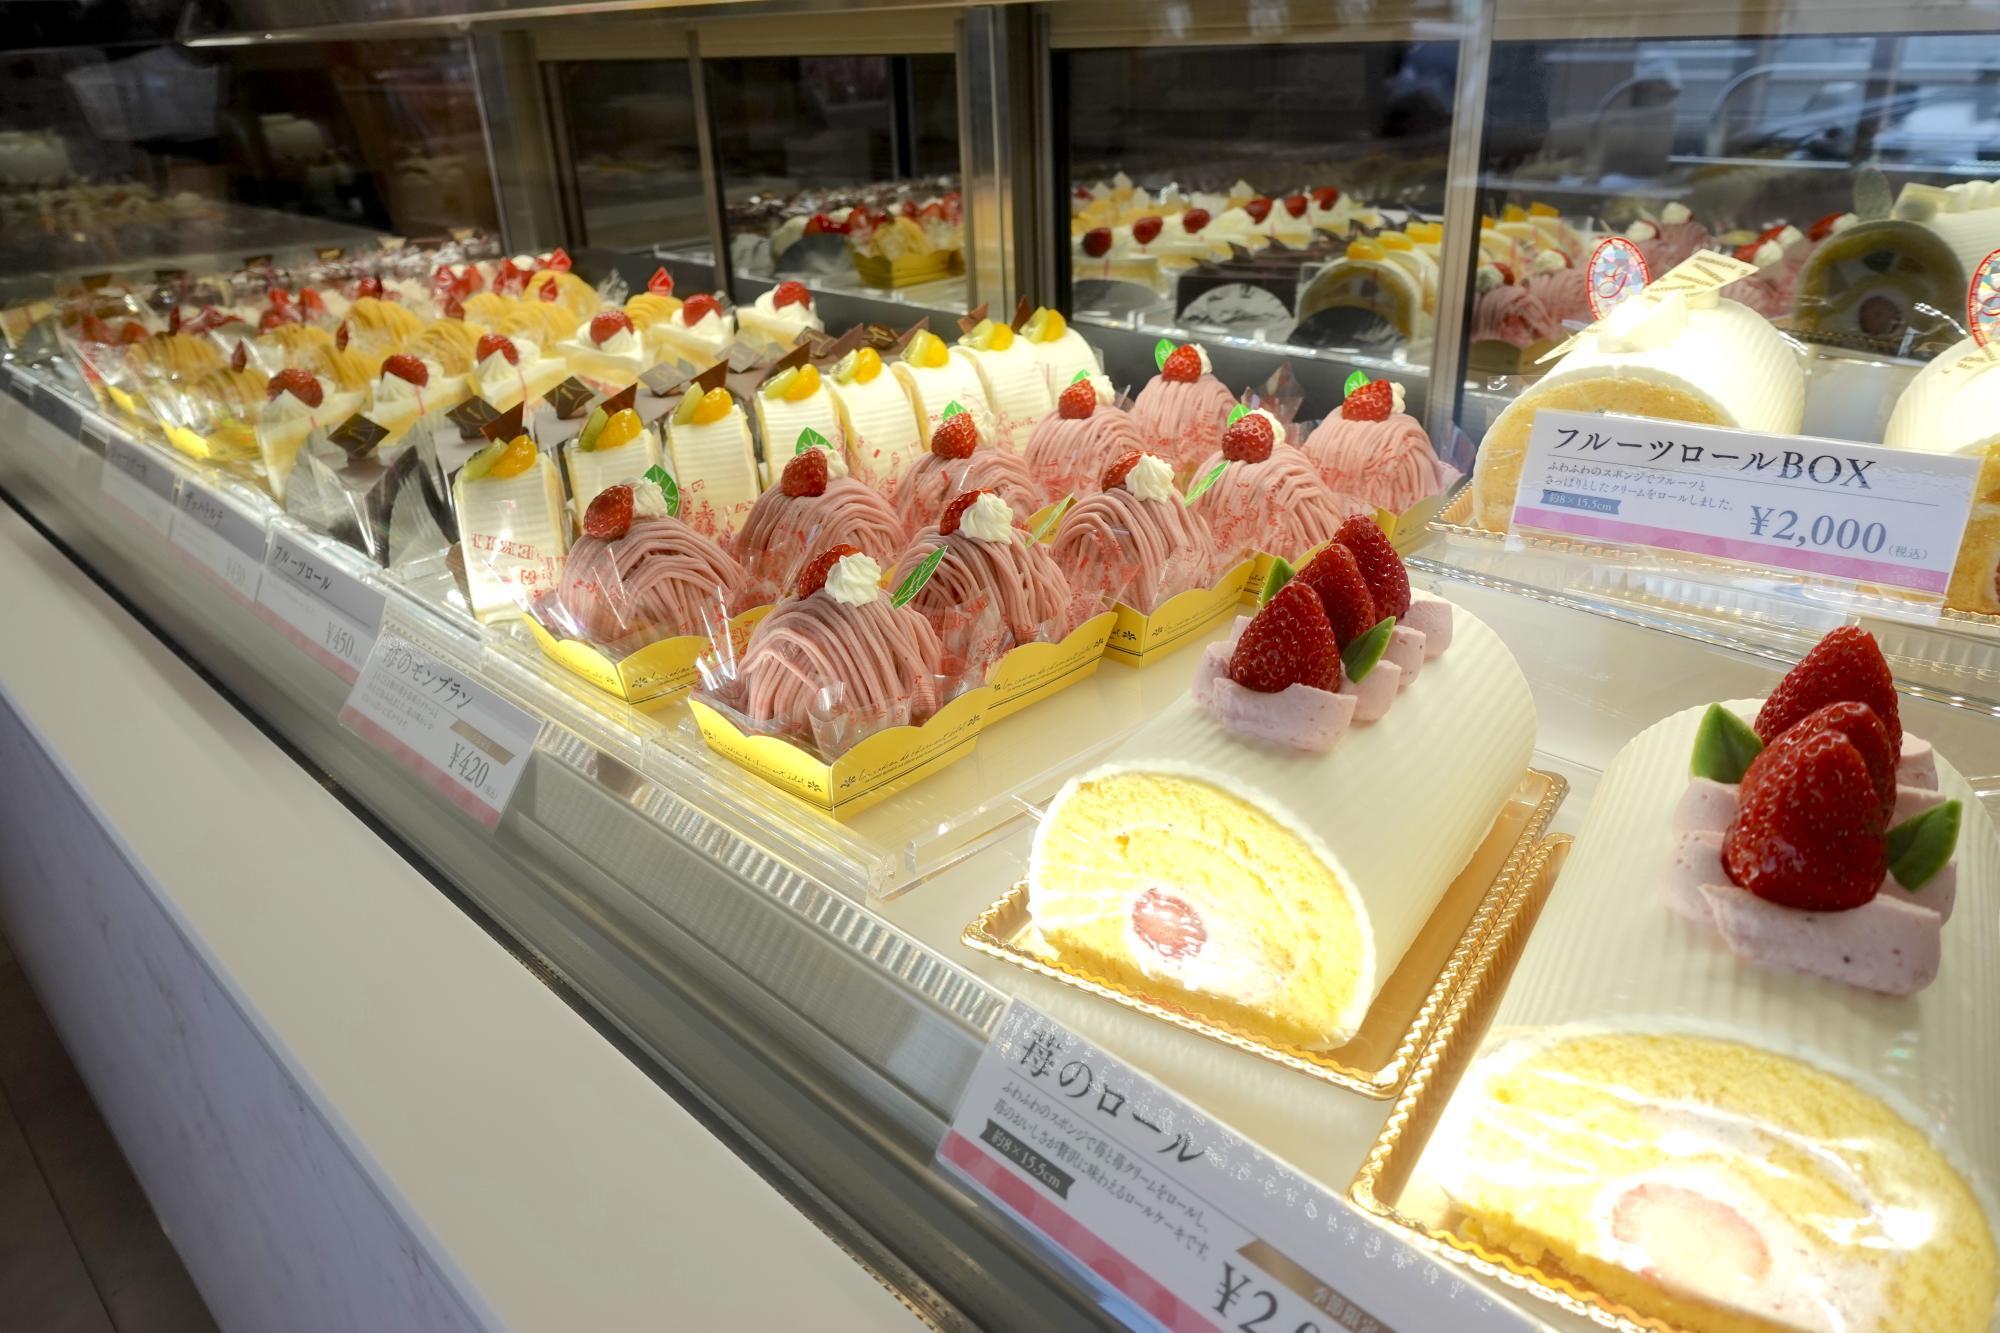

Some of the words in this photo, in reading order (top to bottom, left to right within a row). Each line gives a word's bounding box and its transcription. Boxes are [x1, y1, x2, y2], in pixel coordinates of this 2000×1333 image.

[1554, 427, 1877, 490] フルーツロールBOX
[1750, 505, 1887, 554] ¥2,000
[273, 545, 333, 591] フルーツロール
[325, 621, 354, 658] ¥450
[448, 741, 490, 788] ¥420
[1022, 1030, 1204, 1164] 苺のロール
[992, 1127, 1062, 1190] 約8×15.5cm
